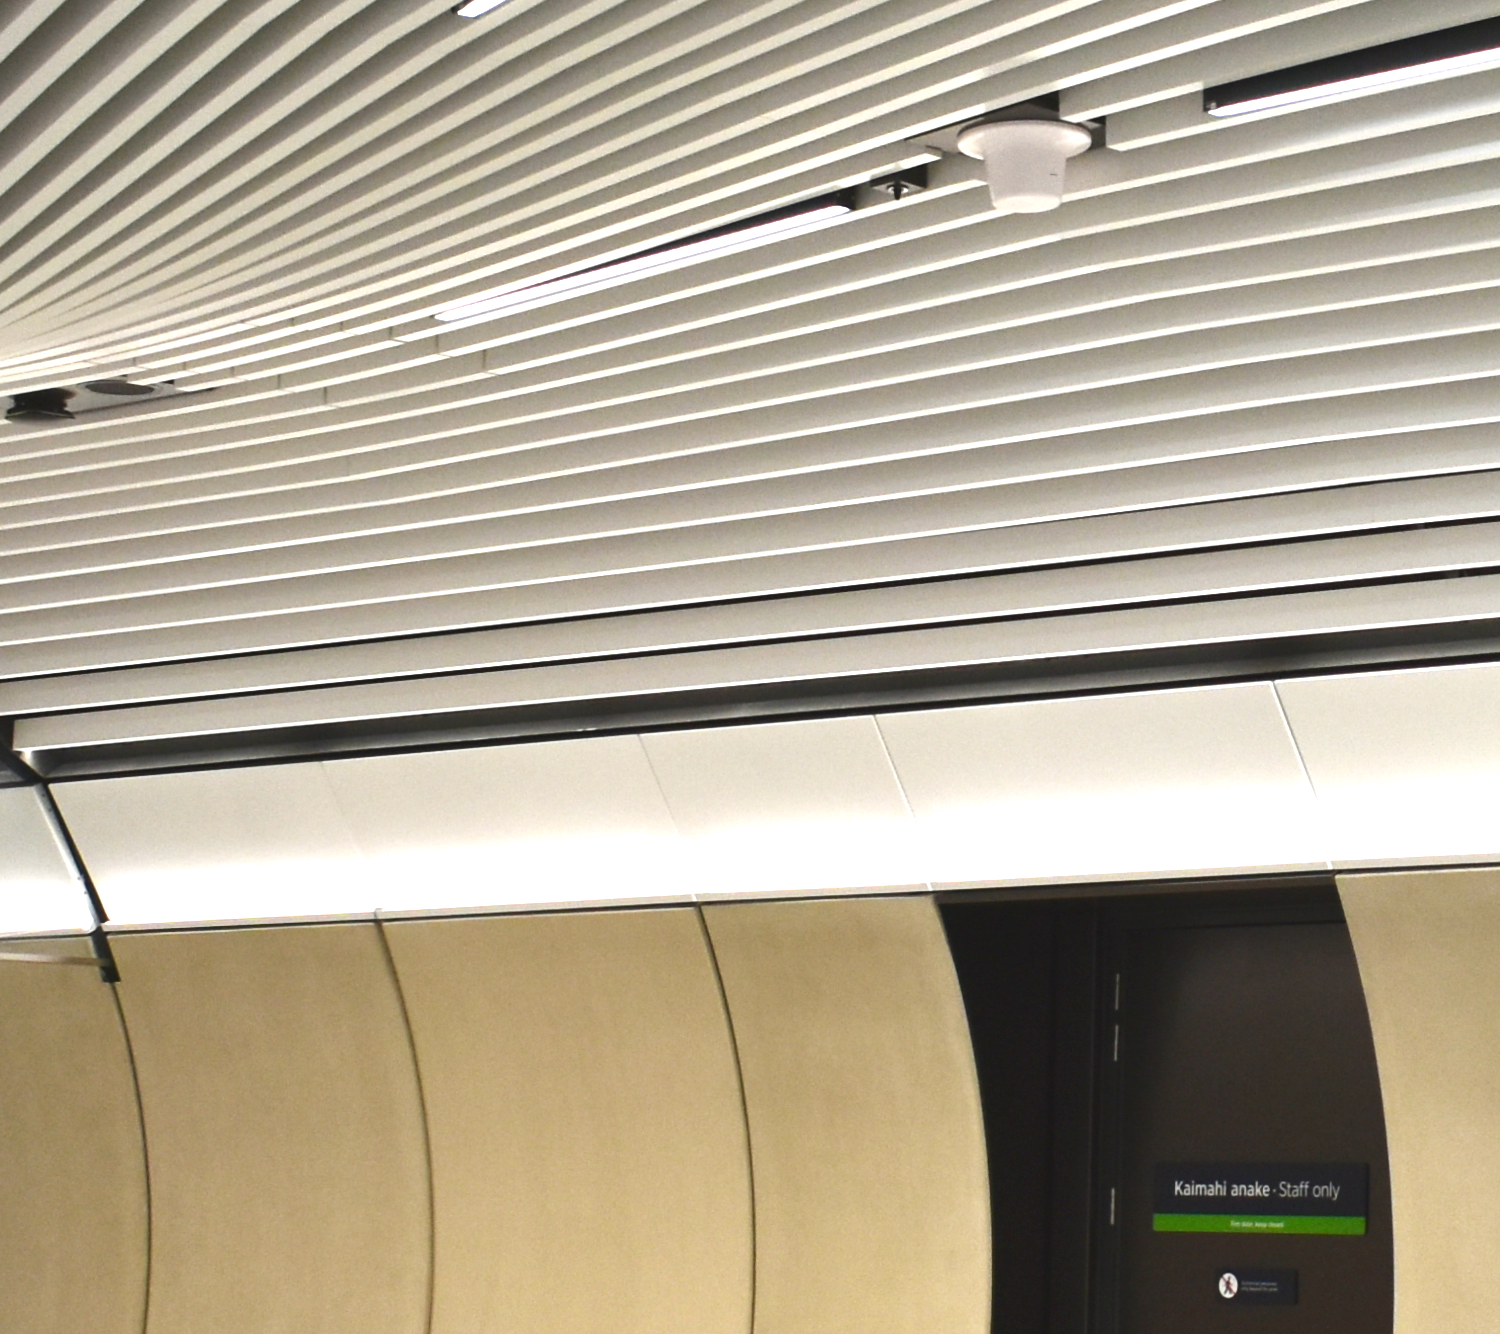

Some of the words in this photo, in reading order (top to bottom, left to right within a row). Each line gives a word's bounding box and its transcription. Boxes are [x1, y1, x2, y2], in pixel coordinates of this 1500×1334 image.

[1174, 1180, 1228, 1197] Kaimahi
[1230, 1180, 1271, 1198] anake
[1278, 1180, 1310, 1198] Staff
[1312, 1182, 1341, 1201] only
